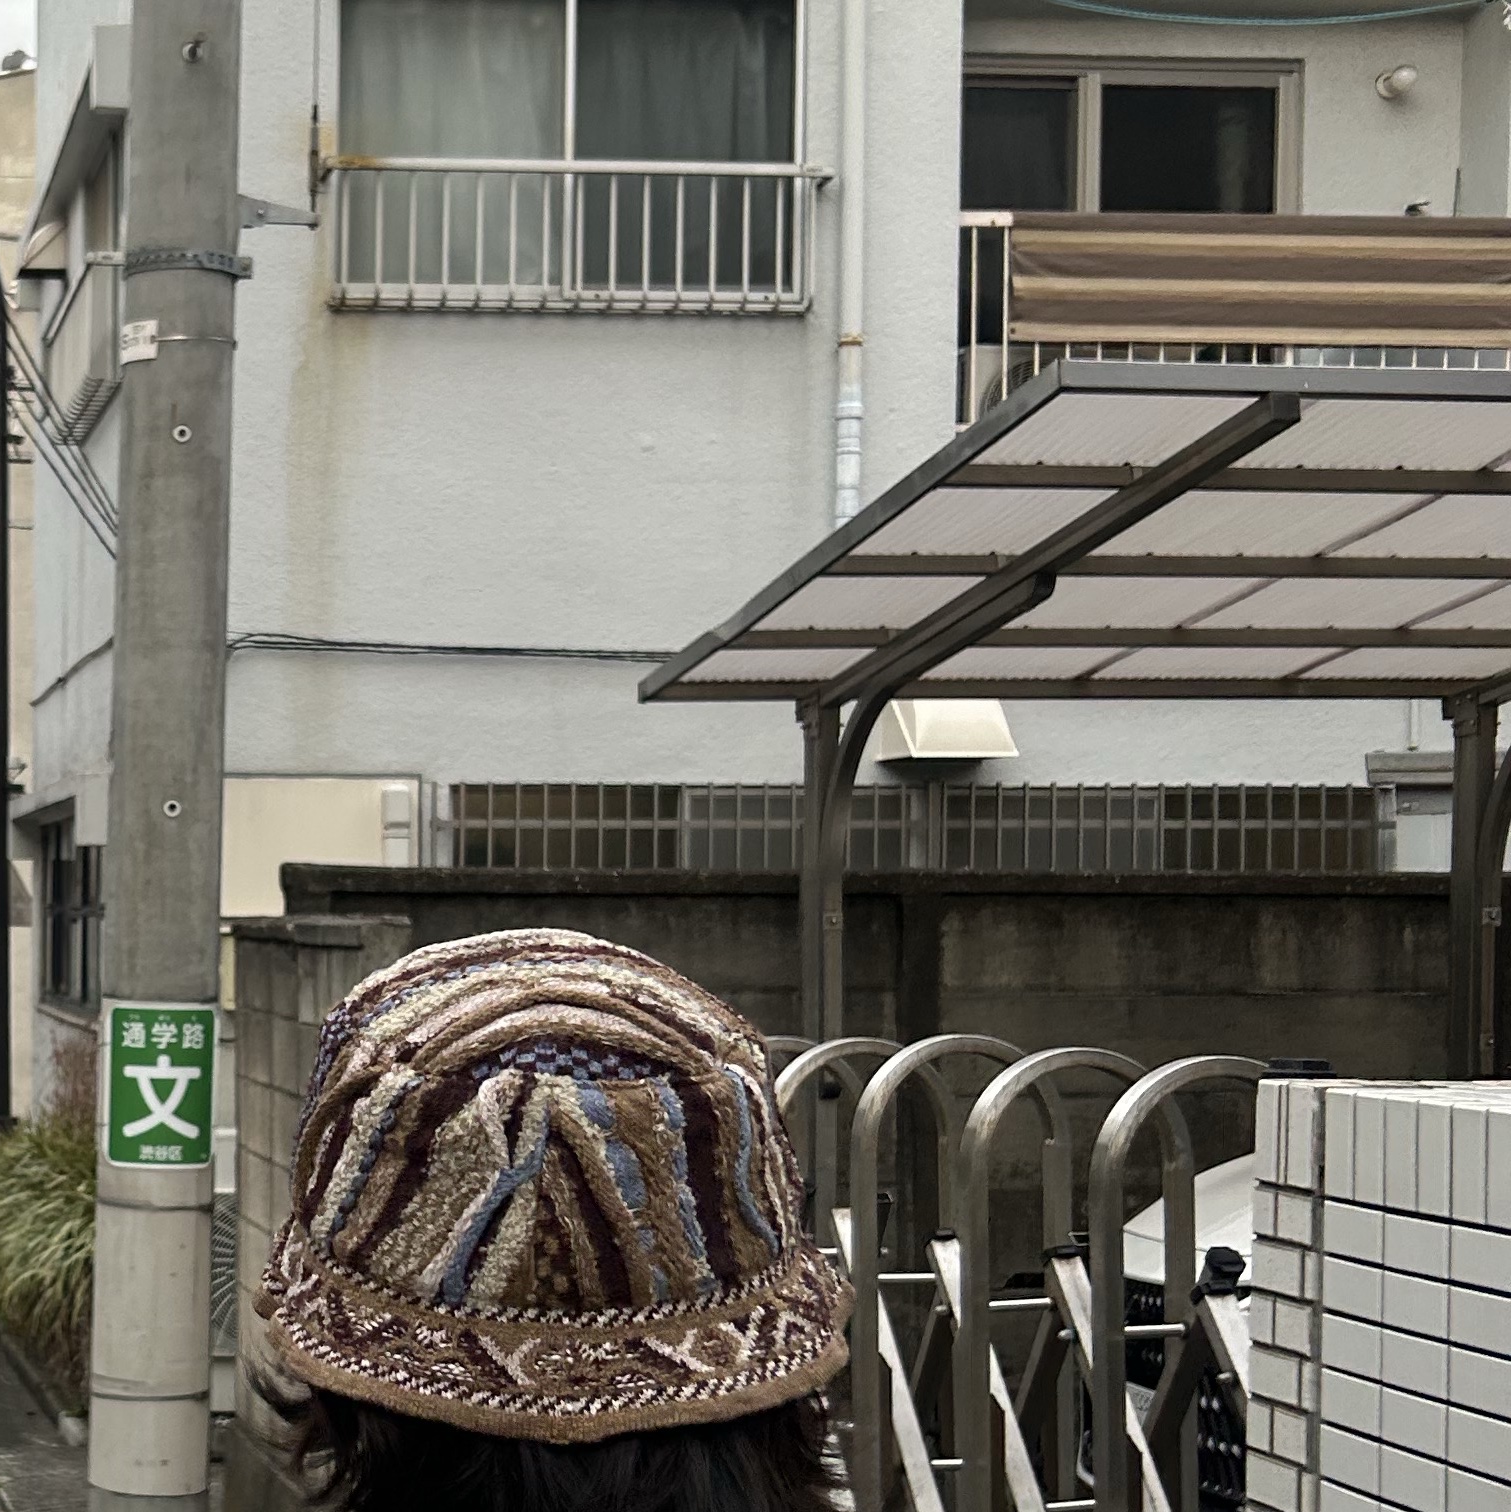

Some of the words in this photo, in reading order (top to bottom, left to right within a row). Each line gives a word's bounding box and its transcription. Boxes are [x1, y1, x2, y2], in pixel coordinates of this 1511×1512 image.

[121, 1021, 205, 1049] 通学路
[122, 1053, 202, 1139] 文
